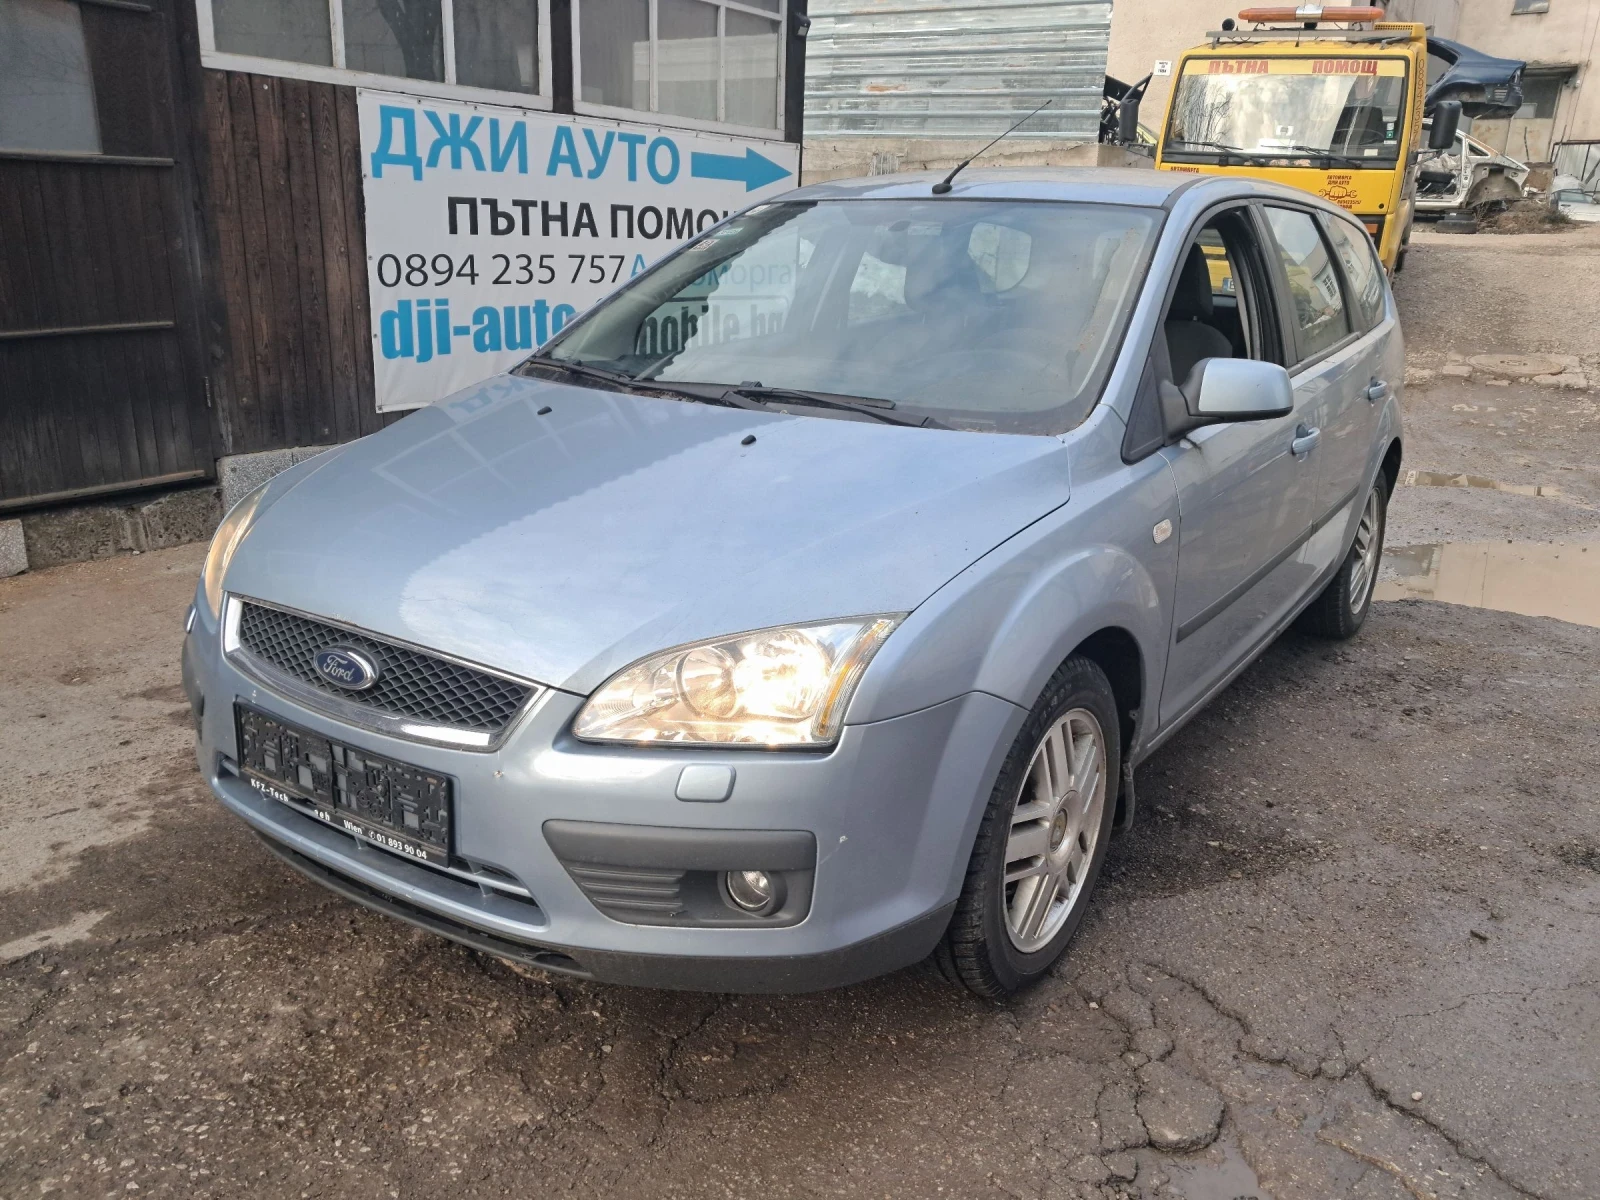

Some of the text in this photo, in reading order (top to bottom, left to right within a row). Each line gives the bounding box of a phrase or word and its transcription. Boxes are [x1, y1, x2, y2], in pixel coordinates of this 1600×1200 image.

[1208, 60, 1378, 76] ПЪТНА ПОМОЩ
[371, 105, 680, 185] ДЖИ АУТО
[448, 196, 736, 240] ПЪТНА ПОМО
[377, 253, 626, 288] 0894 235 757
[323, 654, 355, 681] Ford
[343, 820, 363, 834] Wien
[376, 833, 386, 844] 01
[388, 838, 403, 851] 893
[404, 844, 415, 855] 90
[416, 849, 427, 859] 04
